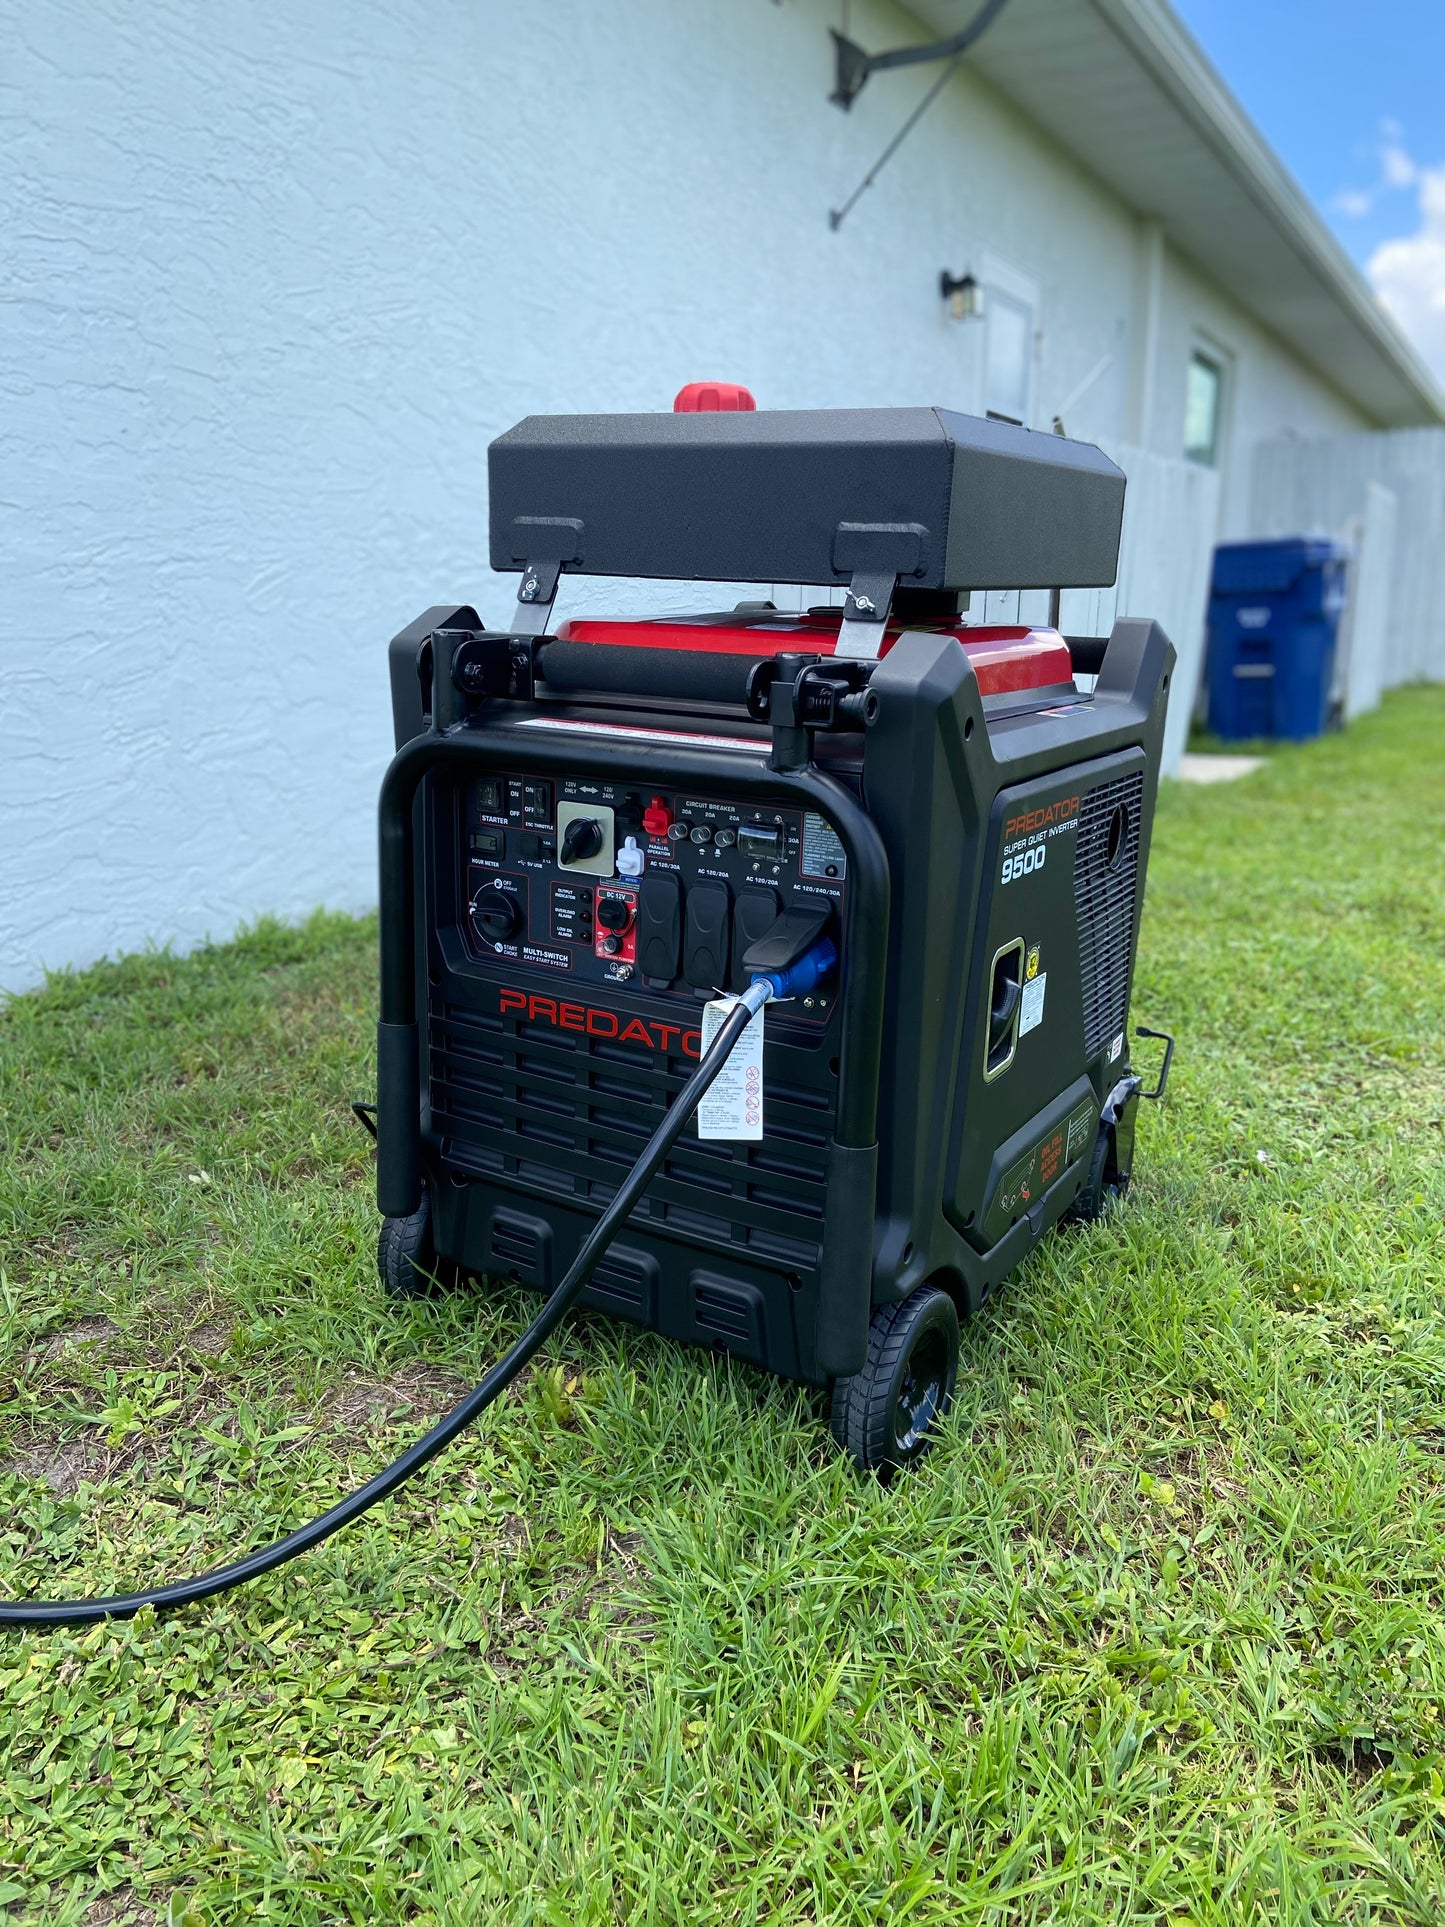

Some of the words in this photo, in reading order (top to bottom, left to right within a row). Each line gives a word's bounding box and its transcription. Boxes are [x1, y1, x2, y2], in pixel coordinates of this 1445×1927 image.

[686, 801, 708, 809] CIRCUIT
[709, 804, 735, 812] BREAKER
[482, 815, 508, 825] STARTER
[1006, 796, 1080, 840] PREDATOR
[1004, 839, 1026, 855] SUPER
[1028, 830, 1047, 845] QUIET
[1048, 819, 1078, 837] INVERTER
[649, 844, 669, 852] PARALLEL
[484, 860, 500, 868] METER
[1001, 845, 1046, 884] 9500
[802, 885, 840, 896] 120/240/30A
[523, 946, 568, 962] MULTI-SWITCH
[536, 956, 550, 964] START
[550, 958, 568, 968] SYSTEM
[604, 974, 624, 982] GROU
[499, 988, 702, 1058] PREDATO
[1041, 1145, 1061, 1172] ACCESS
[1042, 1161, 1058, 1182] DOOR
